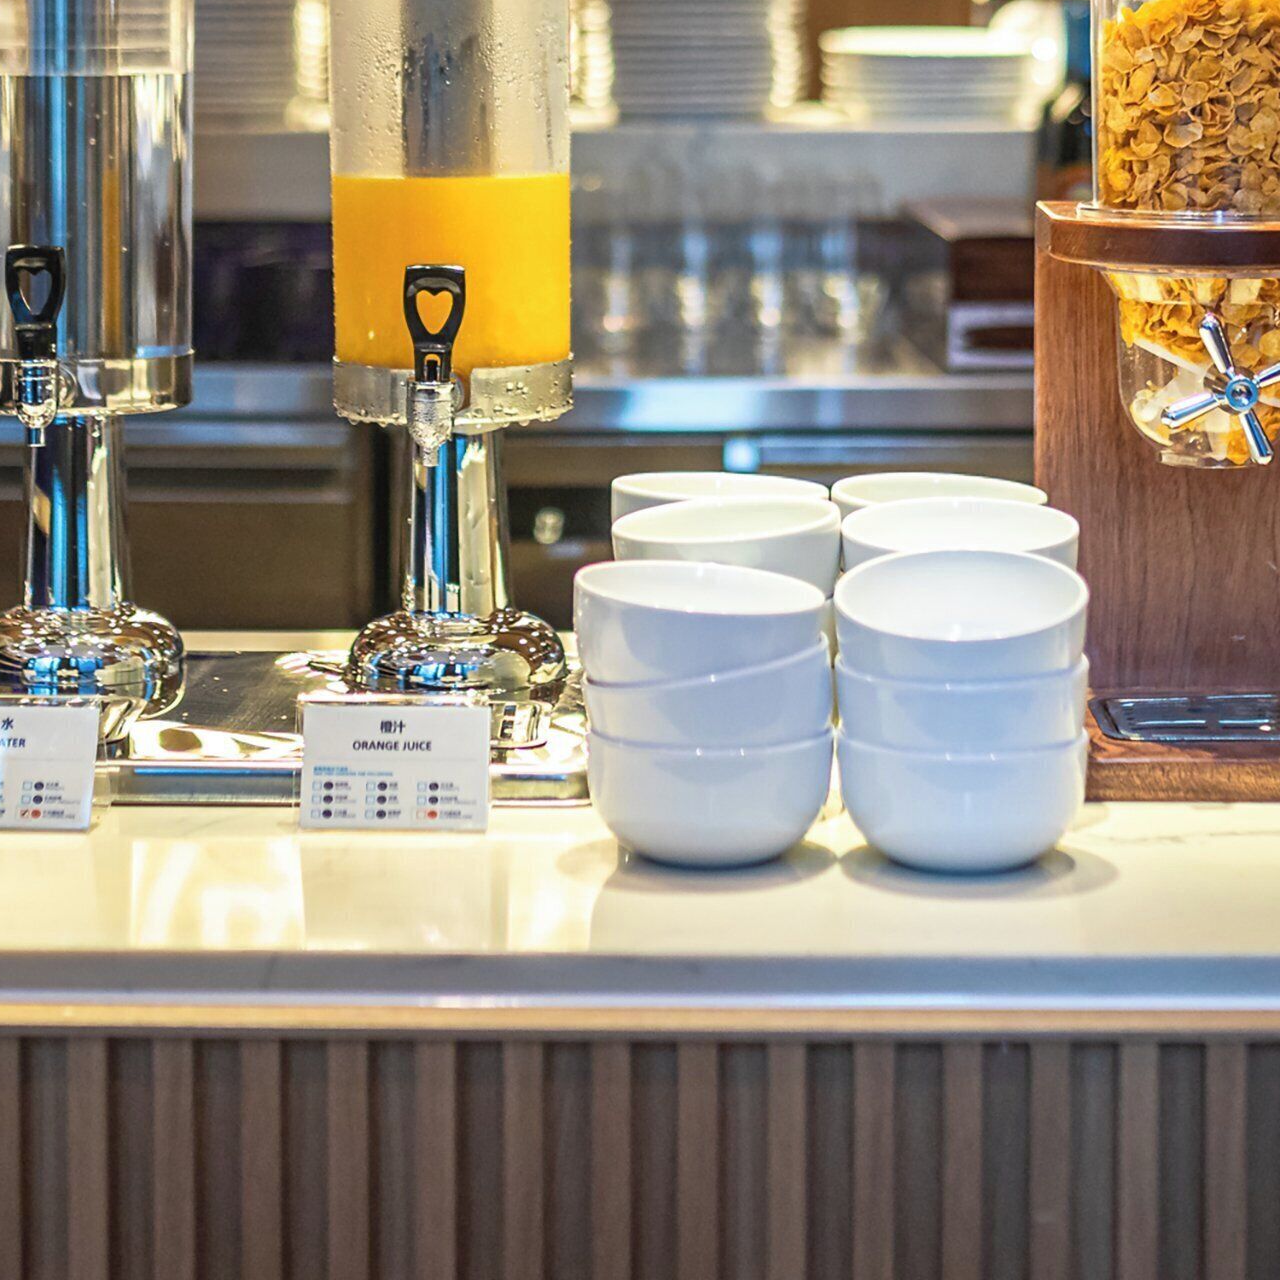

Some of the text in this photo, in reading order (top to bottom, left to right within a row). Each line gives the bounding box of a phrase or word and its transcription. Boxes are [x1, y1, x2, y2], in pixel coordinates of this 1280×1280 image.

[1, 717, 14, 730] 水
[380, 719, 406, 734] 橙汁
[352, 740, 432, 751] ORANGE JUICE
